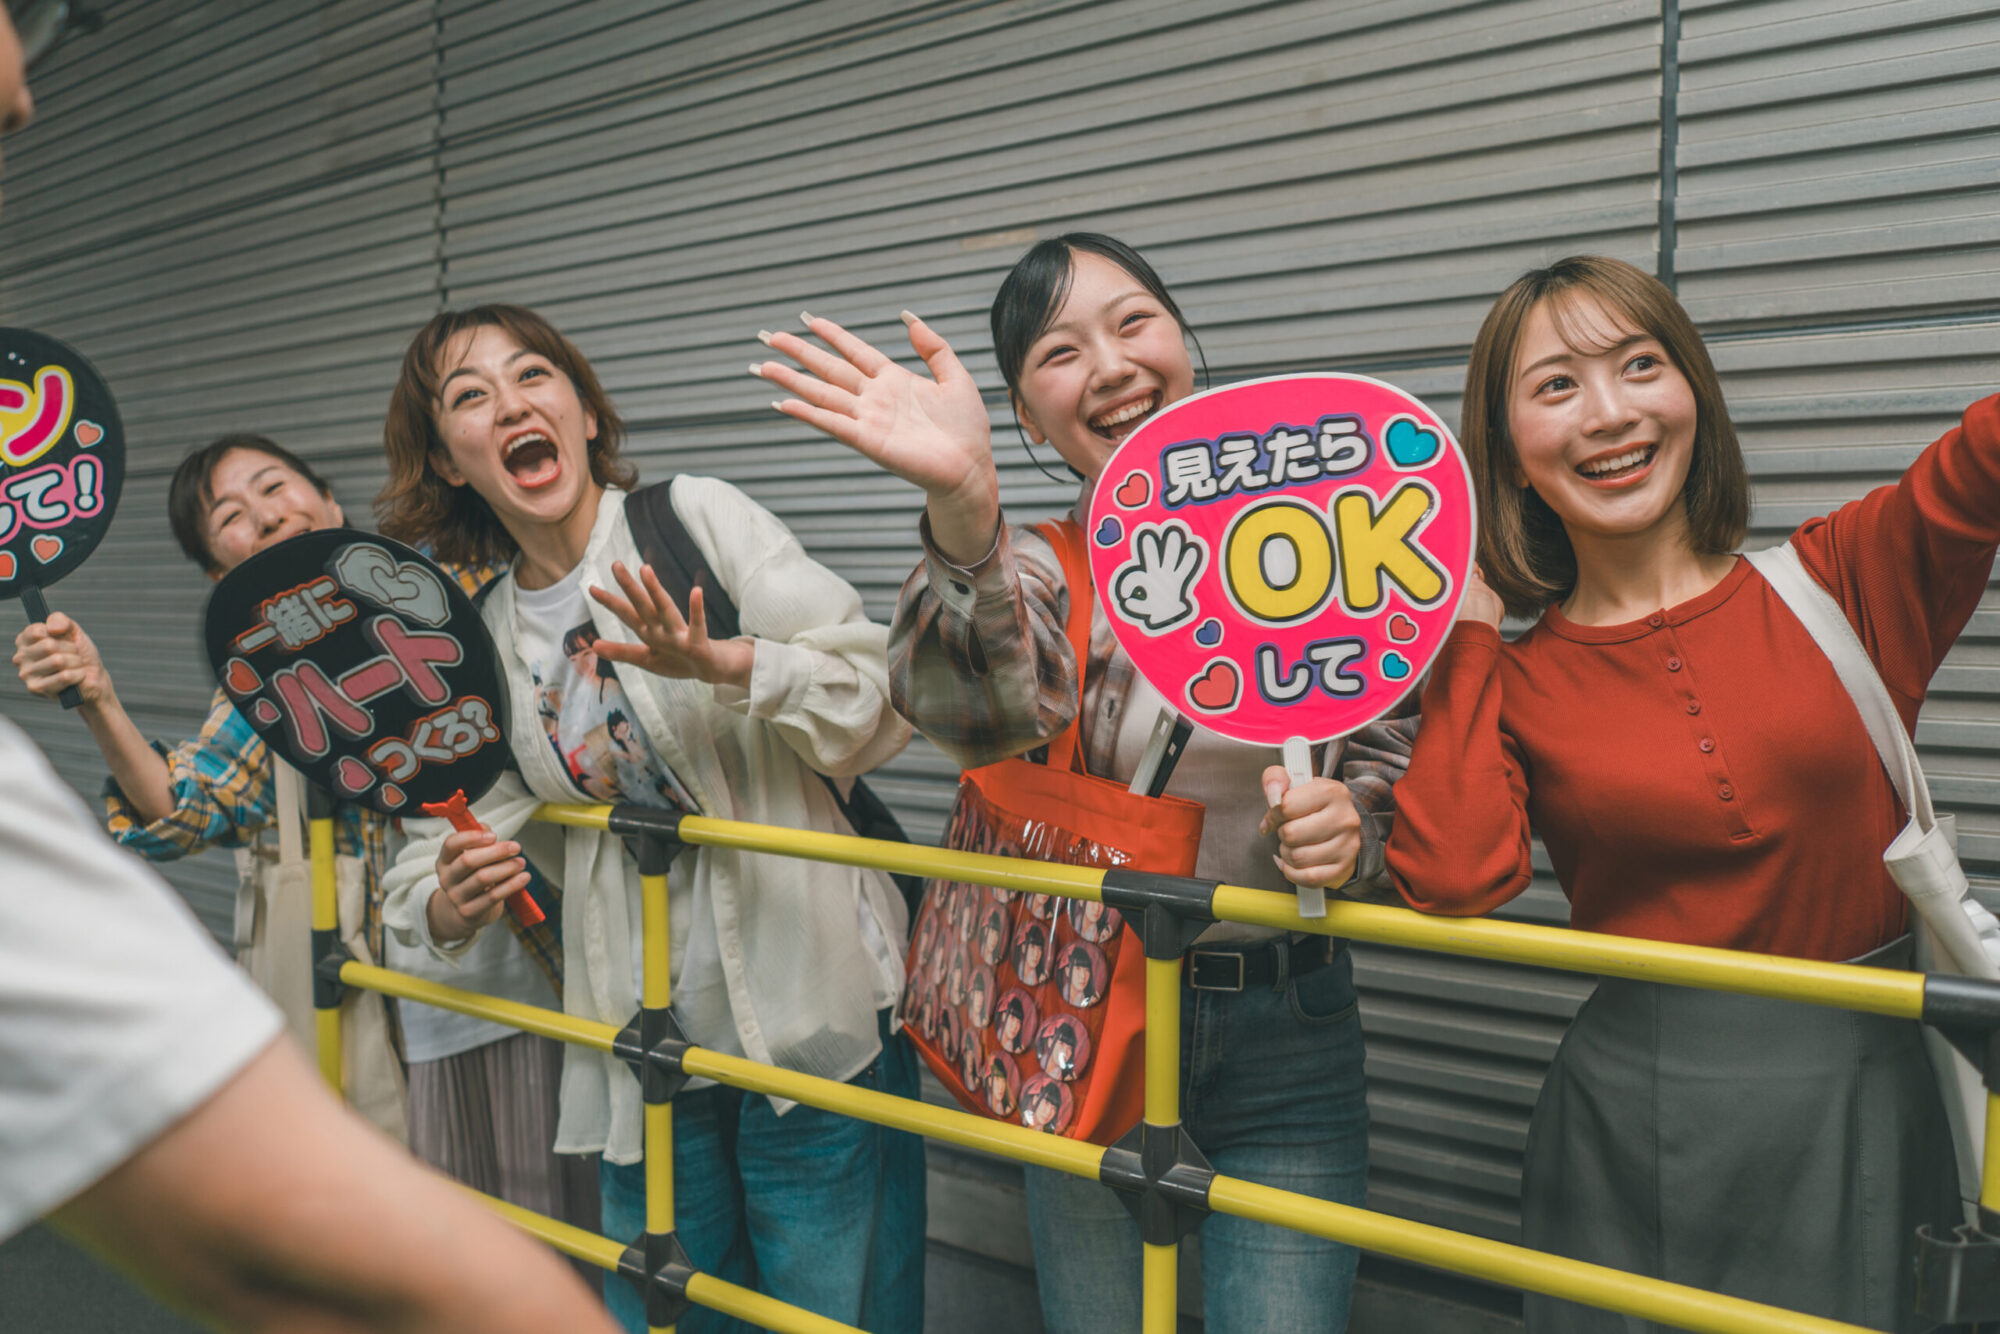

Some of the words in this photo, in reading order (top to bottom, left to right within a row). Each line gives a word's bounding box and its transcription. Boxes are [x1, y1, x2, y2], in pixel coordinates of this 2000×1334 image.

[1162, 414, 1373, 508] 見えたら
[1221, 478, 1450, 625] OK
[236, 577, 356, 652] 一緒に
[274, 615, 462, 755] ハート
[1257, 637, 1367, 704] して
[369, 697, 499, 782] つくろ?
